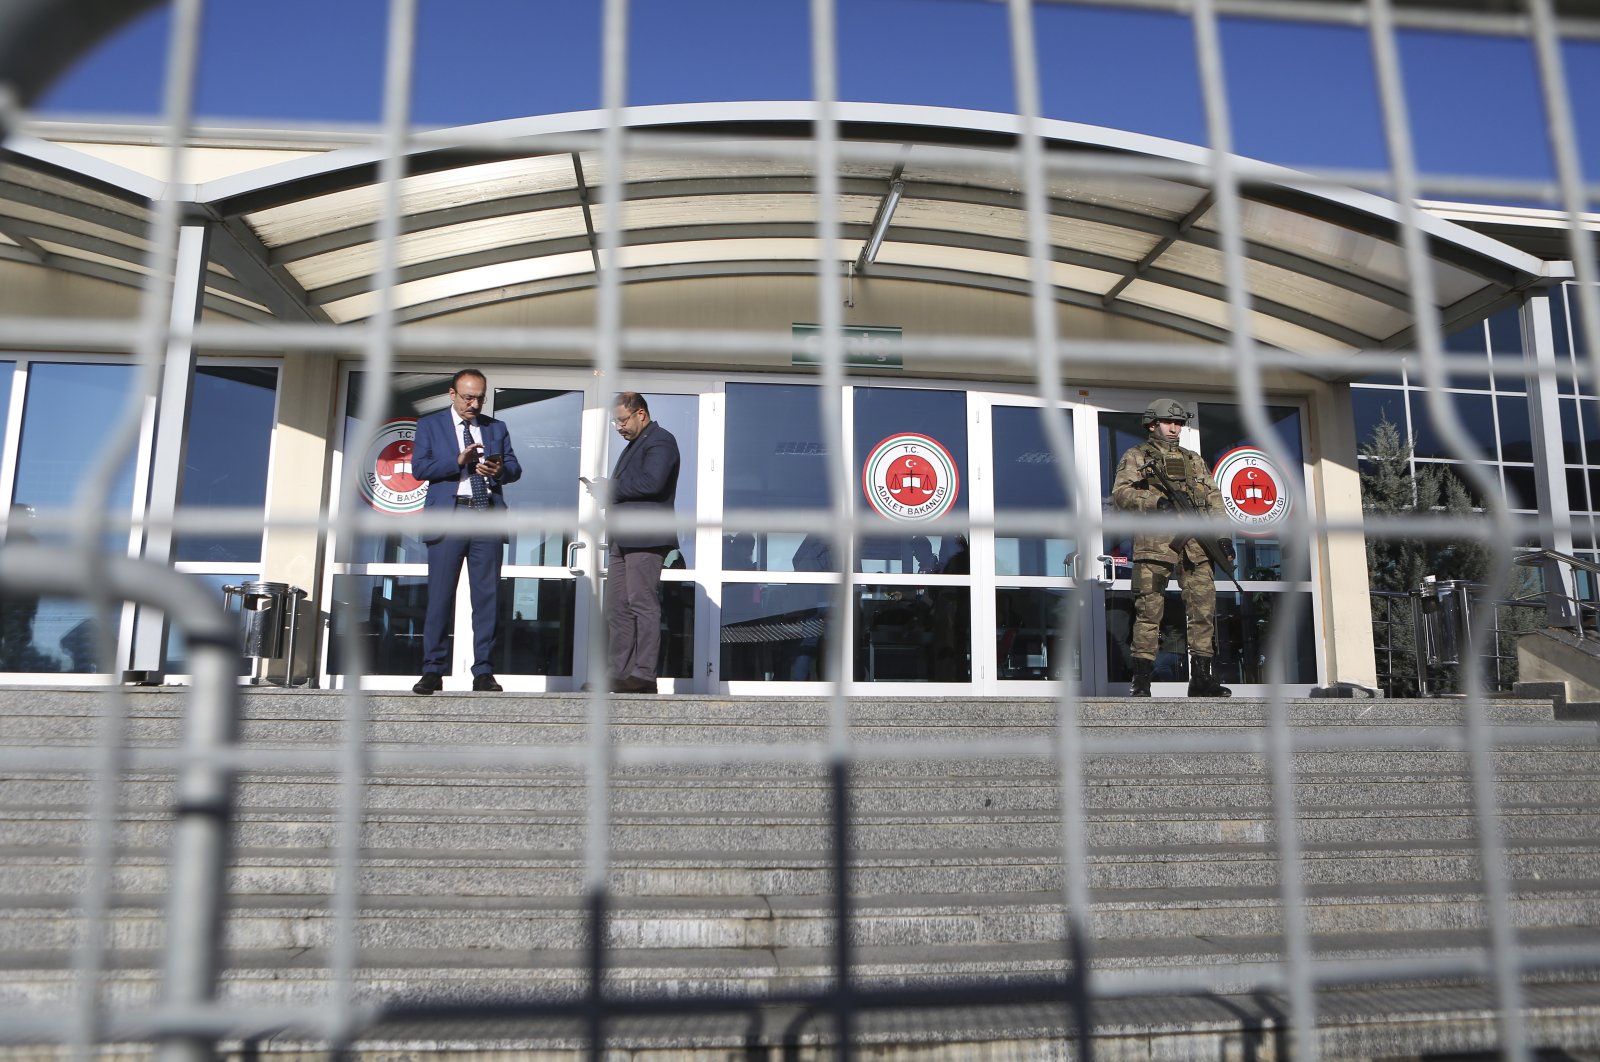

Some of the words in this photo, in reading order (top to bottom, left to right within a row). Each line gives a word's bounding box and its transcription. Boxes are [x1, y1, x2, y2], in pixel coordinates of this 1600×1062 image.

[397, 431, 414, 439] T.C.
[904, 446, 919, 454] T.C.
[367, 472, 393, 500] ADALET
[877, 485, 904, 512] ADALET
[1224, 496, 1248, 522] ADALET
